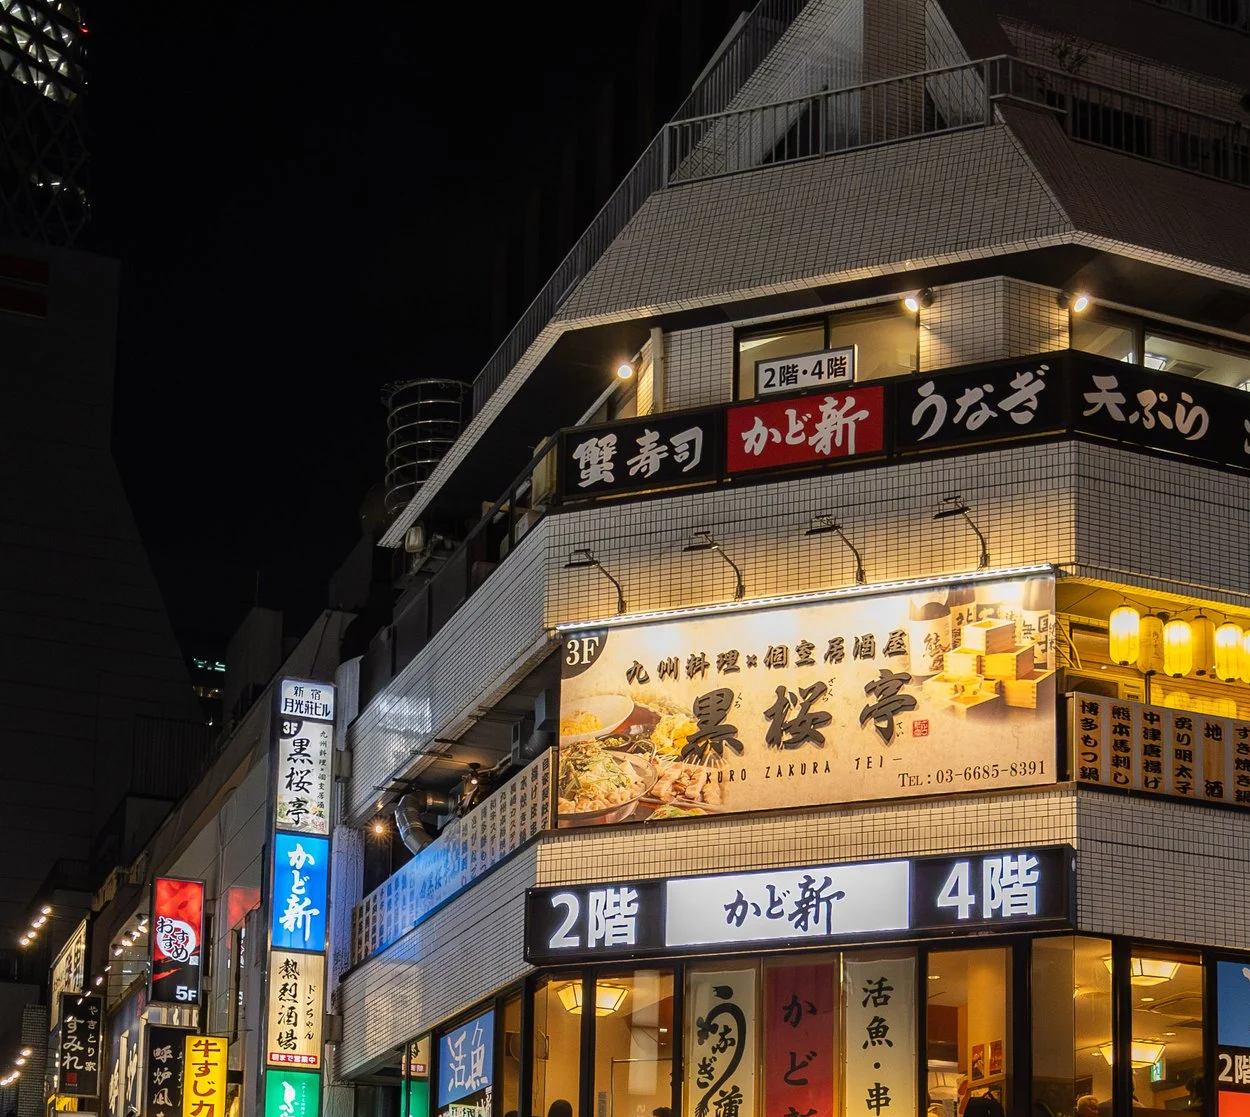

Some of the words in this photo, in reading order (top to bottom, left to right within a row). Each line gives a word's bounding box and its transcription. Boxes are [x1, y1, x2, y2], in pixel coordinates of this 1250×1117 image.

[763, 356, 848, 390] 2階・4階
[911, 365, 1050, 442] うなぎ
[741, 396, 869, 456] かど新
[1083, 375, 1210, 441] 天ぷら
[572, 426, 704, 489] 蟹寿司
[565, 636, 600, 666] 3F
[284, 696, 331, 718] 月光荘ビル
[292, 685, 322, 700] 新宿
[681, 669, 918, 759] 黒桜亭
[282, 722, 299, 736] 3F
[1079, 700, 1100, 783] 博多もつ鍋
[1110, 705, 1133, 786] 熊本馬刺し
[1142, 710, 1163, 790] 中津唐揚げ
[1173, 715, 1194, 796] 炙り明太子
[285, 739, 313, 826] 黒桜亭
[705, 767, 748, 787] KURO
[764, 759, 833, 780] ZAKURA
[279, 844, 320, 941] かど新
[549, 888, 640, 950] 2階
[722, 875, 846, 936] かど新
[936, 854, 1041, 921] 4階
[176, 985, 197, 1001] 5F
[277, 959, 298, 1051] 熱烈酒場
[304, 984, 315, 1041] ドンちゃん
[62, 1017, 84, 1071] すみれ
[85, 1006, 98, 1073] やきとり家
